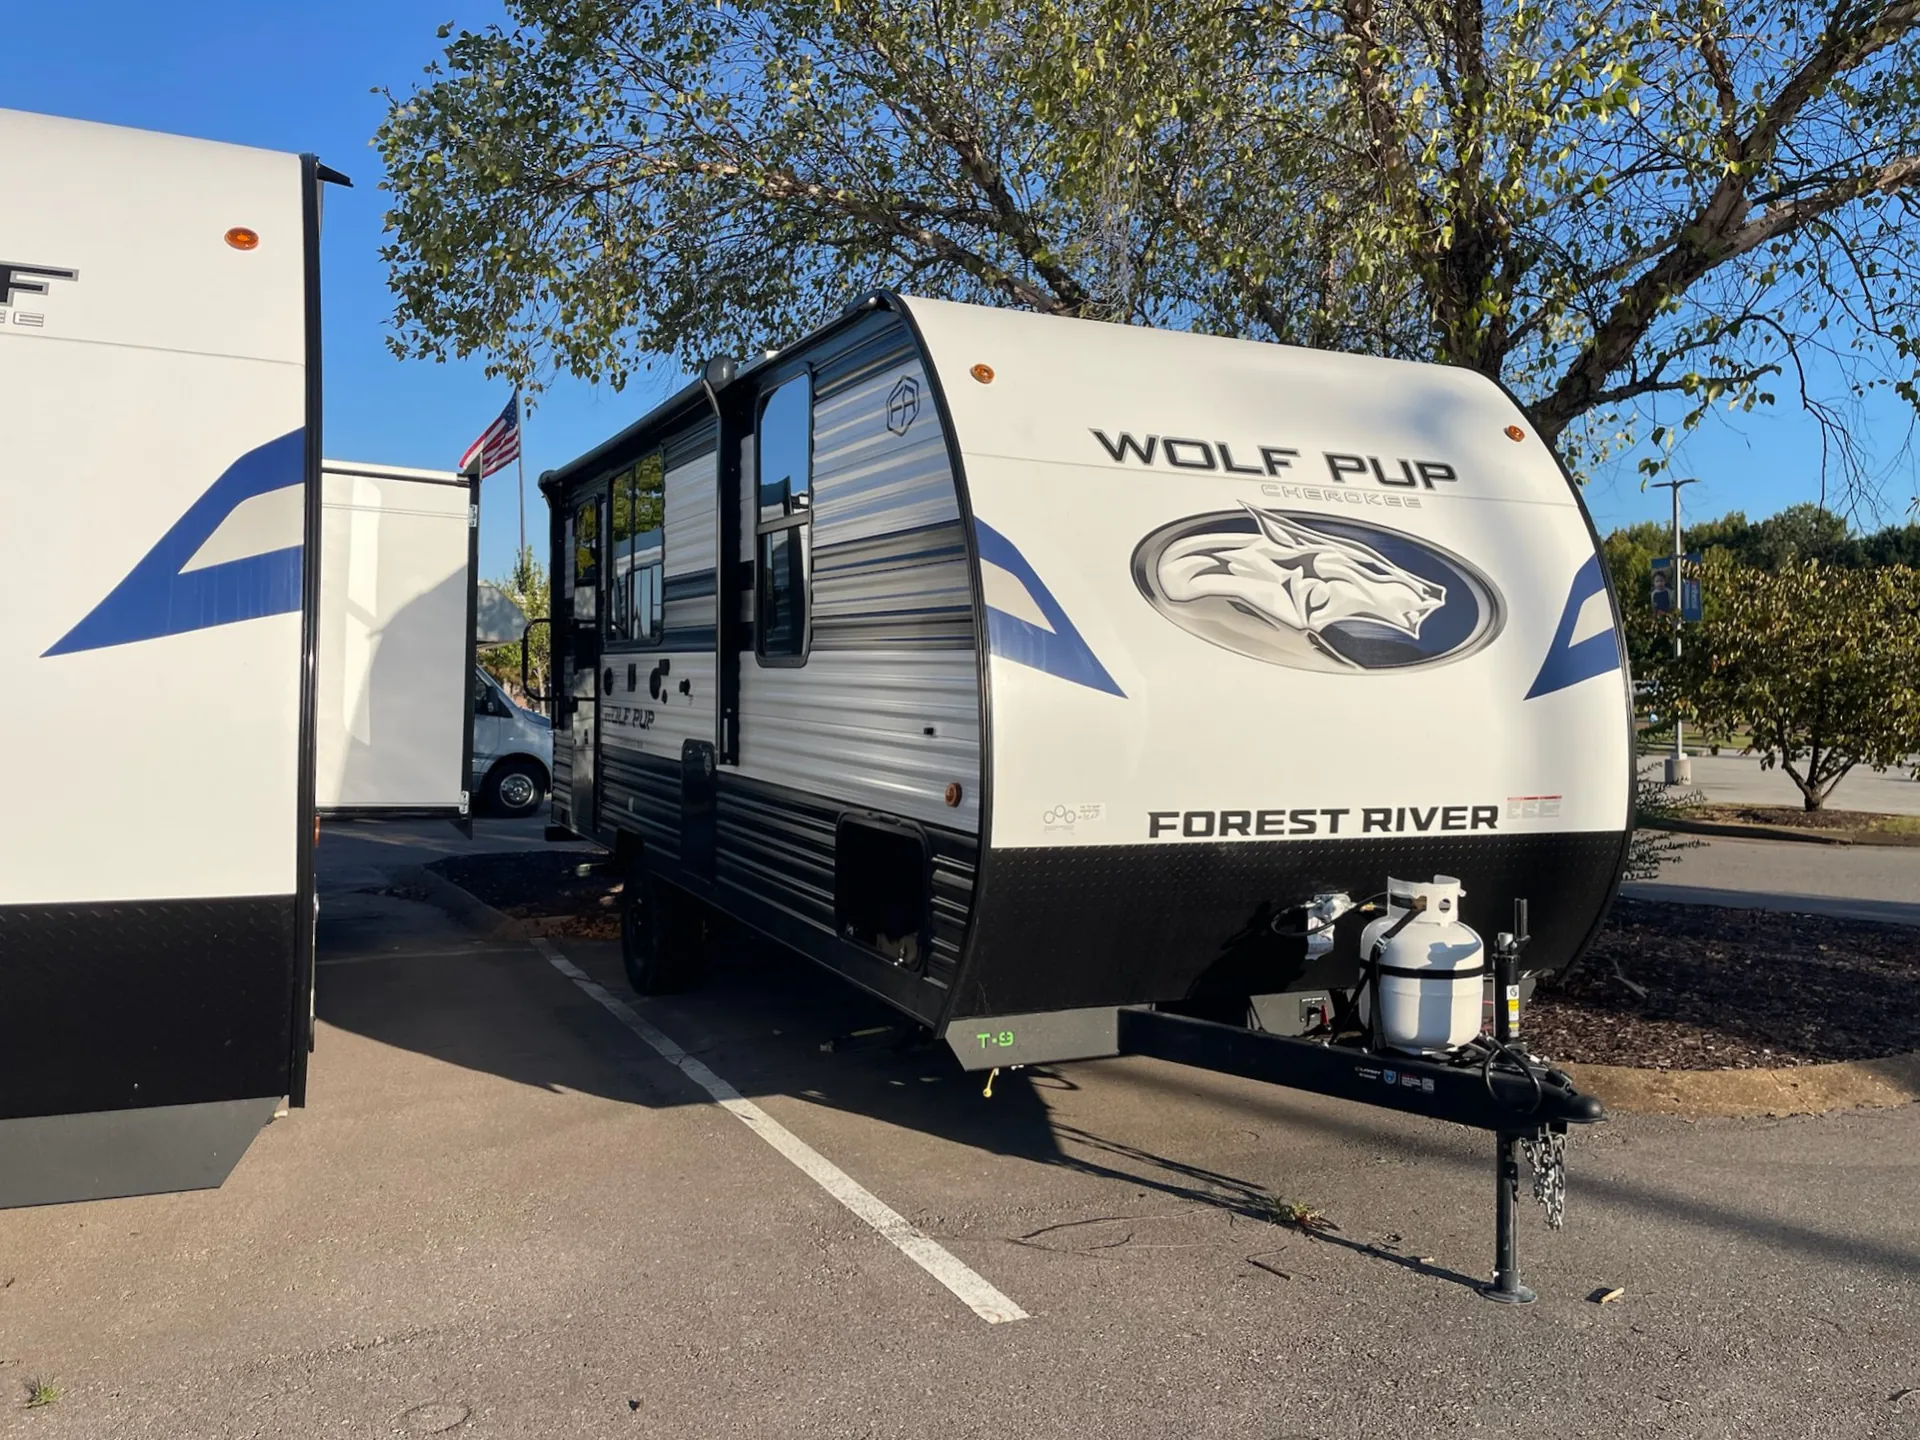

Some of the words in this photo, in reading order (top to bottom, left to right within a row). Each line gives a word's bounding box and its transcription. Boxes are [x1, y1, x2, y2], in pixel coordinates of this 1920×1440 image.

[0, 309, 44, 328] E
[1088, 427, 1301, 477] WOLF
[1322, 451, 1459, 490] PUP
[1261, 484, 1422, 509] CHEROKEE
[1147, 808, 1350, 838] FOREST
[1361, 805, 1499, 833] RIVER
